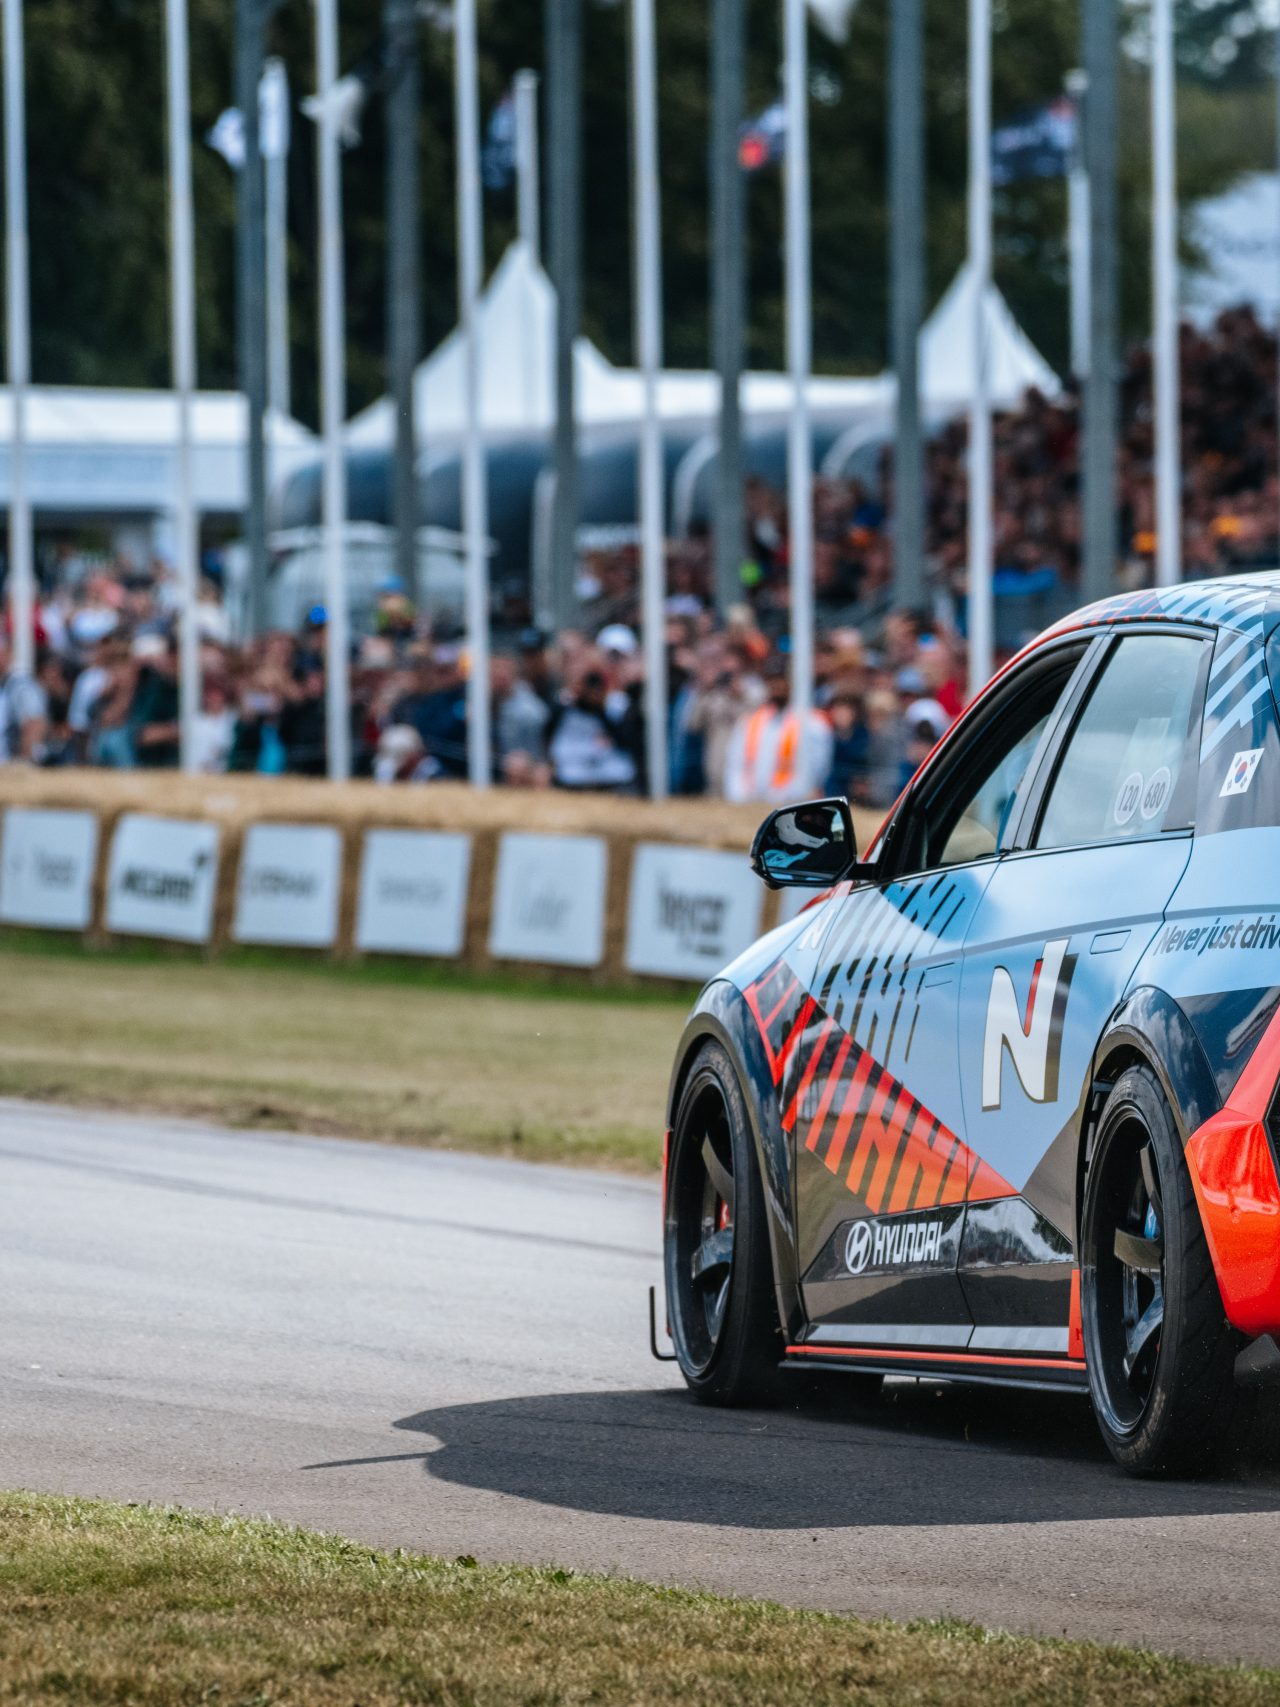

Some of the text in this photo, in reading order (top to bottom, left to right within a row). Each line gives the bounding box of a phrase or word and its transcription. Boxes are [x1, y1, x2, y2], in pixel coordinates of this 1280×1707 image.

[1154, 926, 1209, 956] Never
[1197, 917, 1244, 956] just
[982, 936, 1079, 1112] N
[872, 1221, 943, 1266] HYUNDAI
